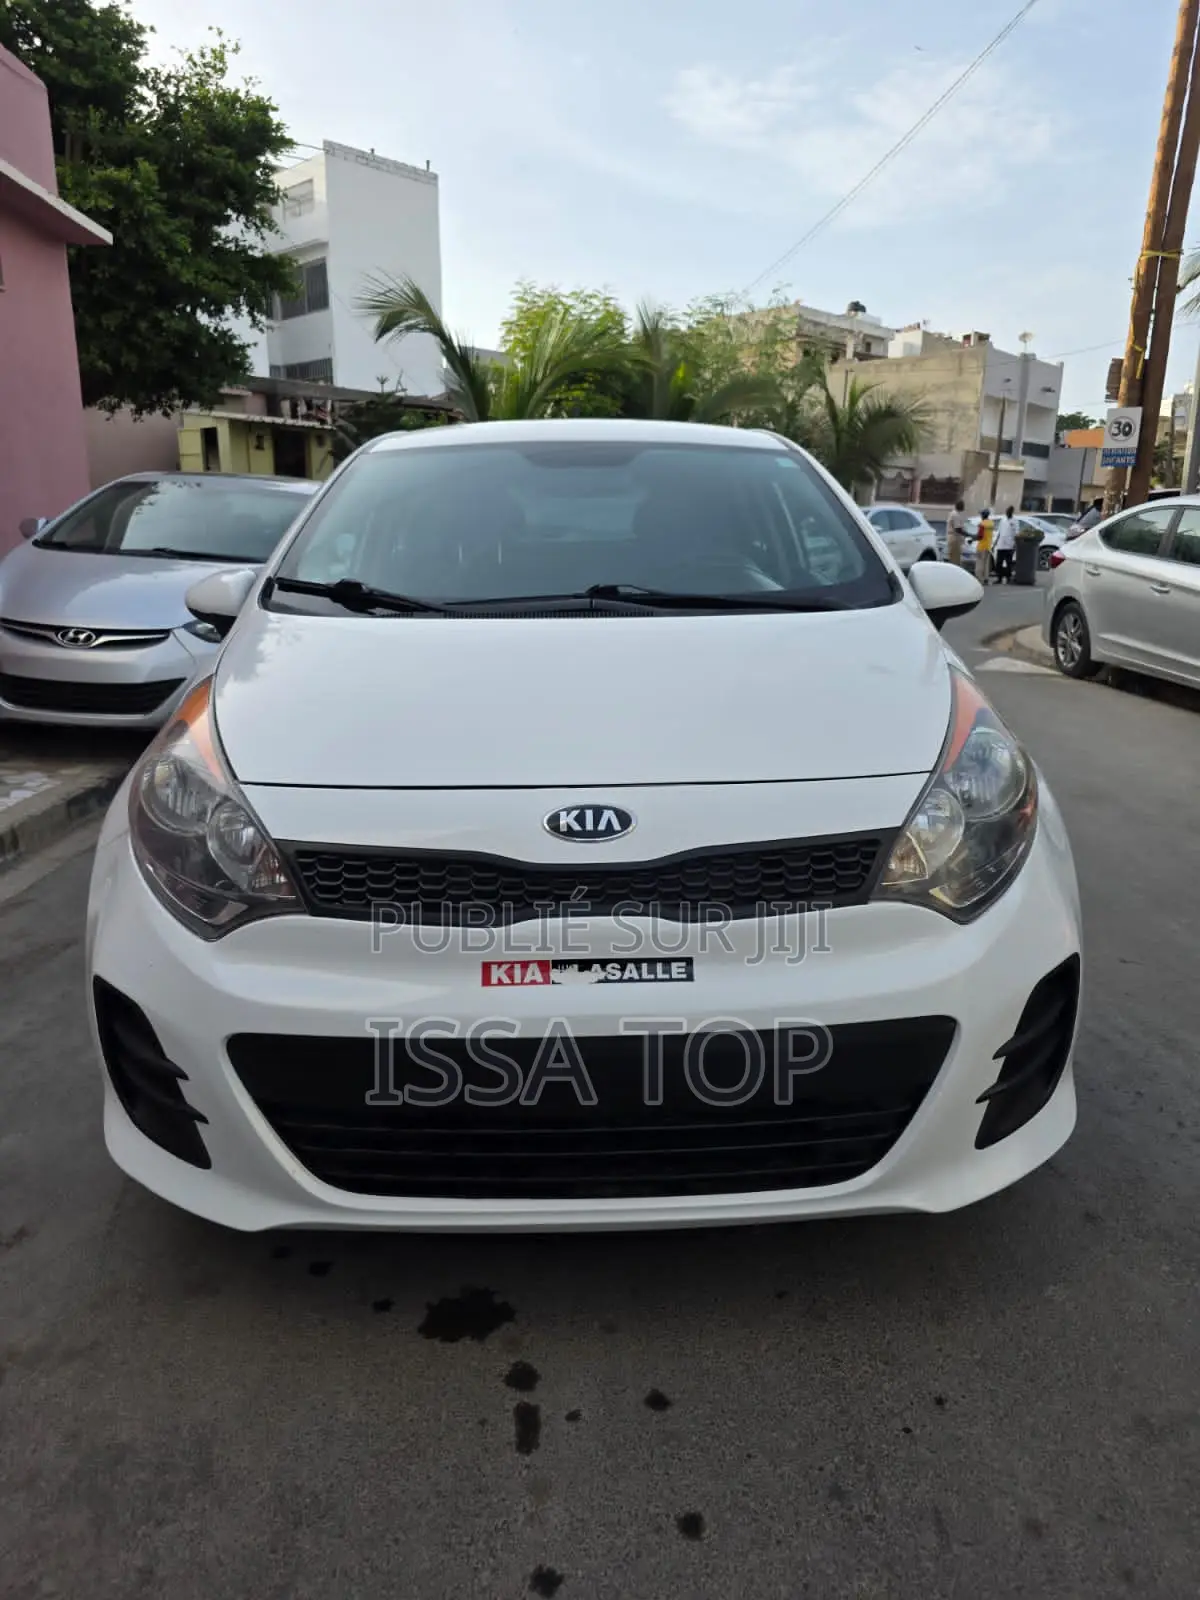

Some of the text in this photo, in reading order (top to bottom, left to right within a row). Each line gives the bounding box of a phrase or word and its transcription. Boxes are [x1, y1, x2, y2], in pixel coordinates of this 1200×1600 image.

[1112, 421, 1133, 437] 30
[559, 809, 621, 832] KIA
[490, 963, 544, 984] KIA
